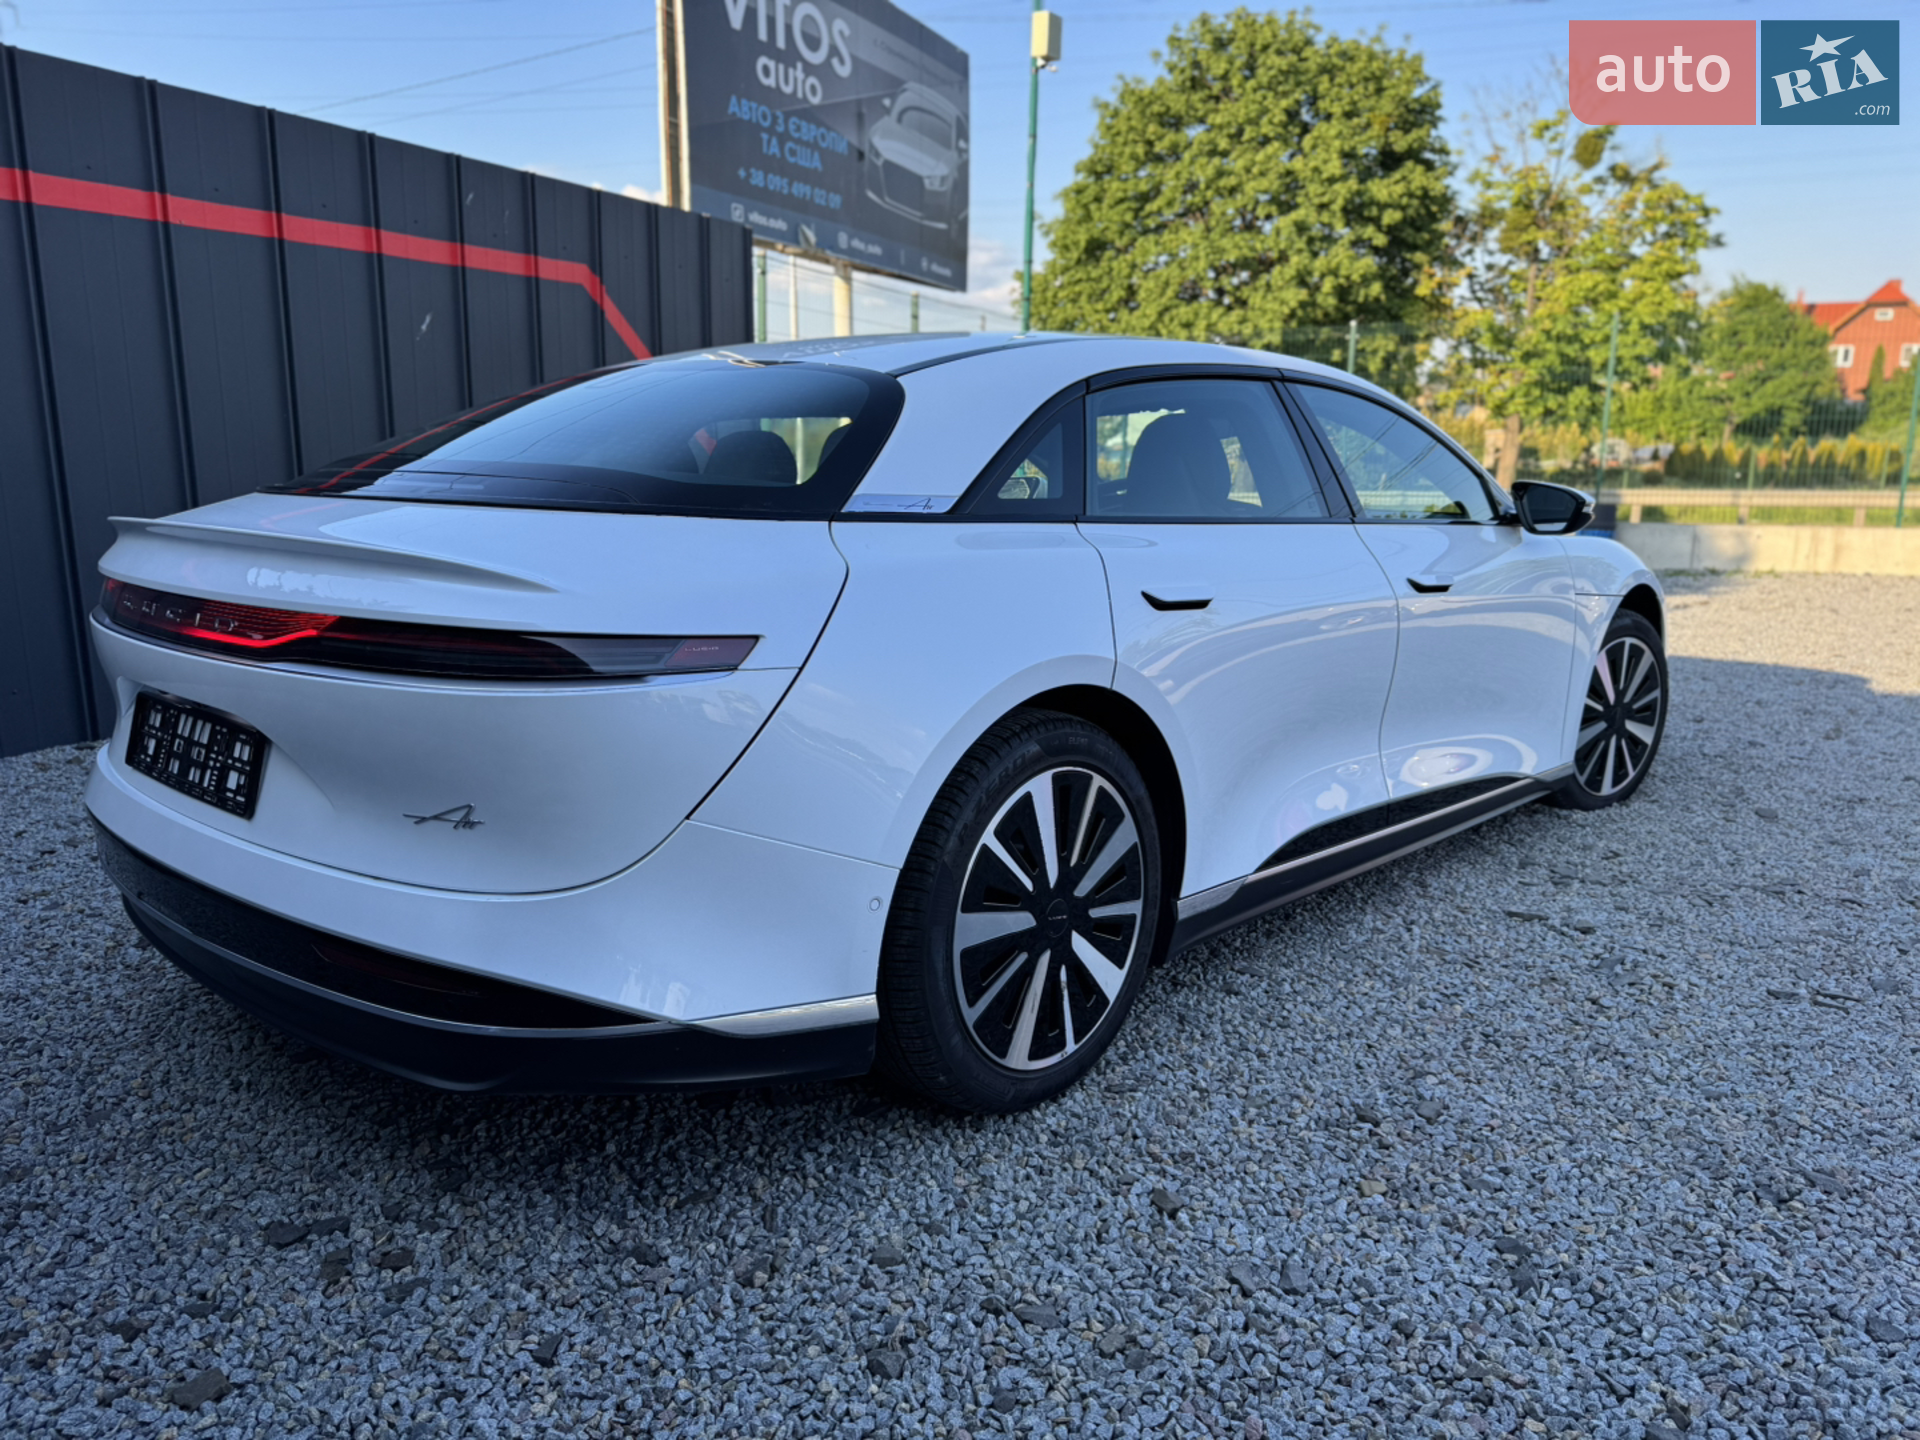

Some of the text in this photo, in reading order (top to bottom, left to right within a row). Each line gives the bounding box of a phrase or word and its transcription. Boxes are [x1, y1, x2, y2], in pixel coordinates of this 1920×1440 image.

[755, 55, 823, 105] auto
[727, 94, 772, 128] АВТО
[788, 116, 849, 156] ЄВРОПИ
[760, 132, 823, 172] ТА США
[749, 167, 765, 188] 38
[767, 173, 789, 195] 095
